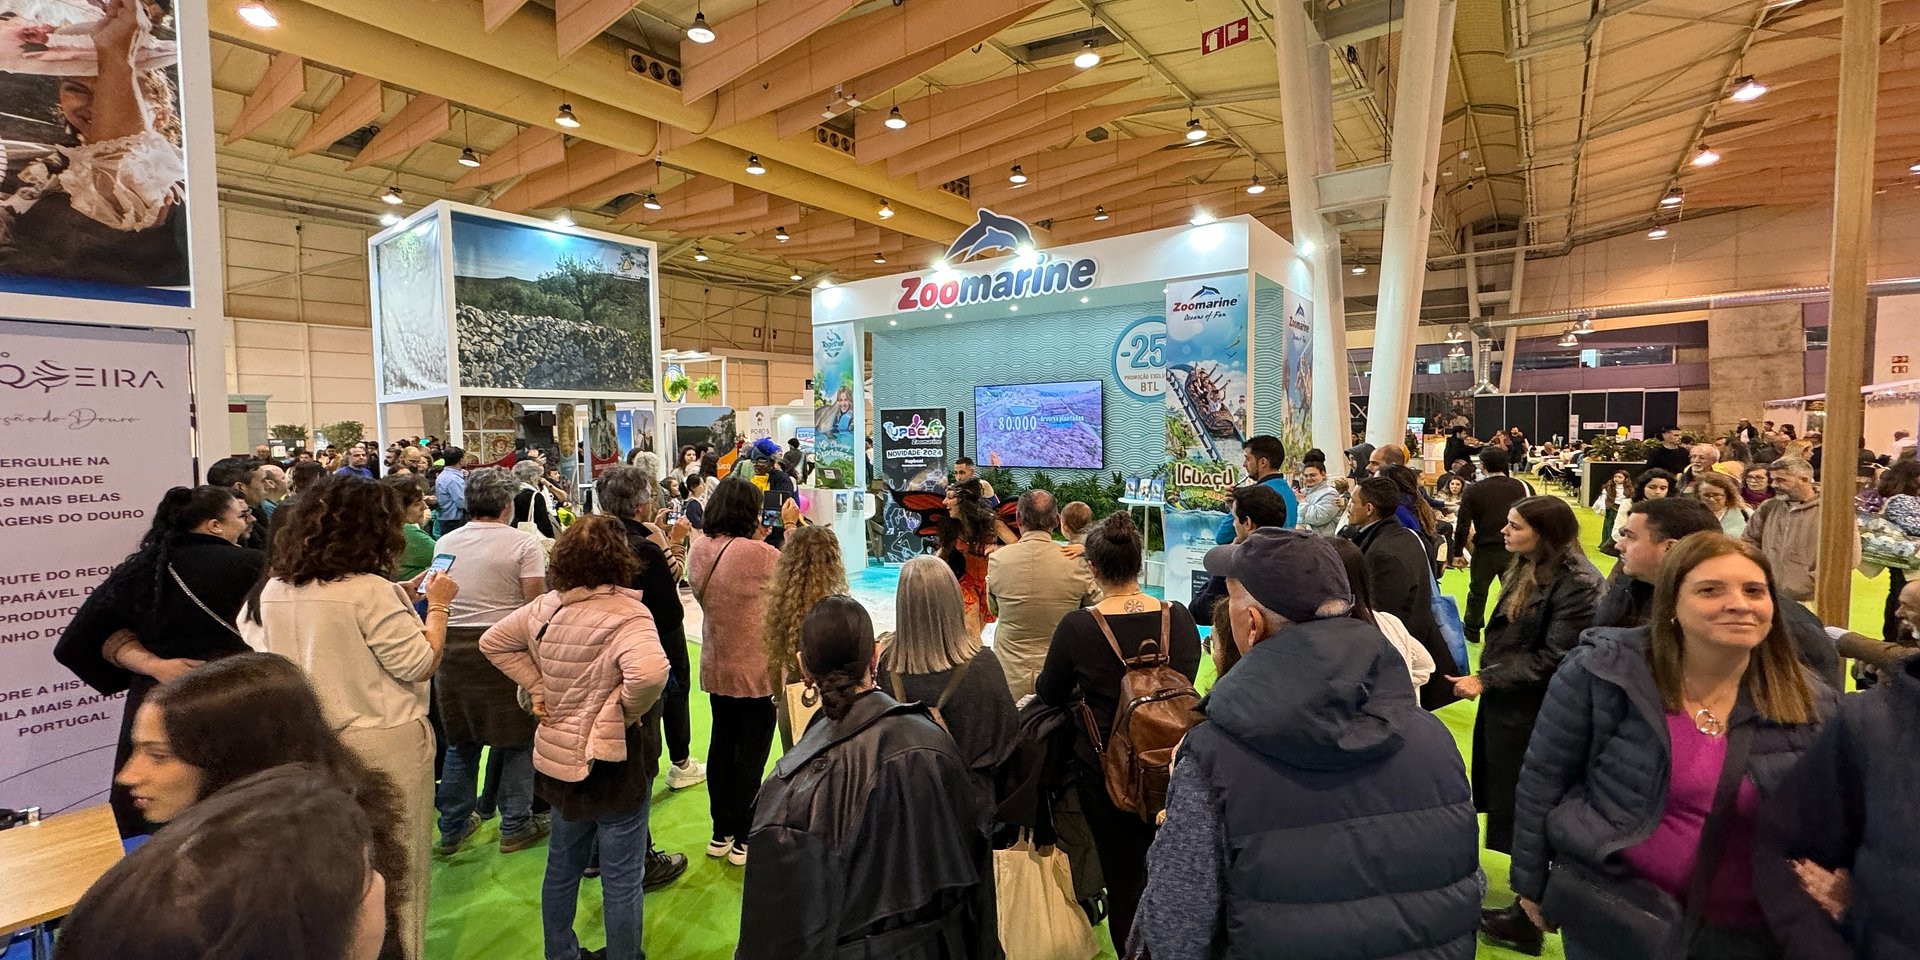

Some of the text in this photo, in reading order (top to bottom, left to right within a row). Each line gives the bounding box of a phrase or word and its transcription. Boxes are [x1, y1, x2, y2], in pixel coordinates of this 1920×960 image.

[897, 253, 1097, 310] Zoomarine
[1172, 297, 1238, 312] Zoomarine
[1140, 381, 1159, 392] BTL
[999, 416, 1037, 430] 80.000
[886, 449, 921, 458] NOVIDADE
[87, 457, 110, 466] NA
[1177, 463, 1234, 489] IGUAÇU
[20, 495, 62, 506] MAIS
[67, 492, 121, 503] BELAS
[58, 513, 82, 523] DO
[87, 509, 144, 521] DOURO
[46, 570, 71, 581] DO
[76, 566, 114, 578] REQ
[37, 686, 49, 696] A
[31, 700, 73, 715] MAIS
[18, 711, 110, 737] PORTUGAL
